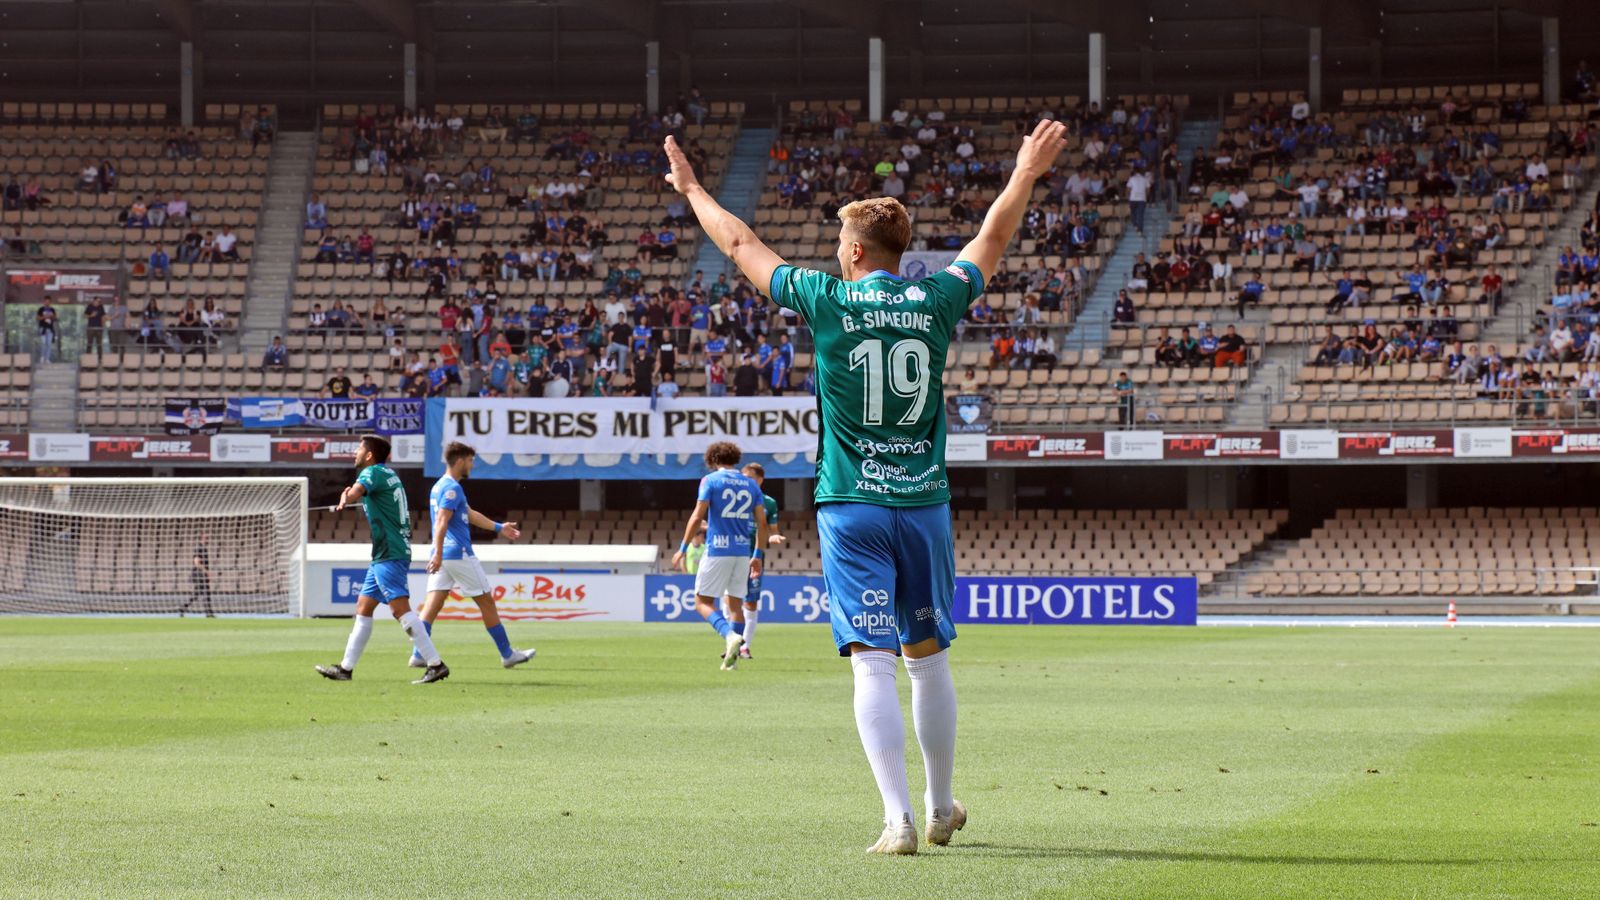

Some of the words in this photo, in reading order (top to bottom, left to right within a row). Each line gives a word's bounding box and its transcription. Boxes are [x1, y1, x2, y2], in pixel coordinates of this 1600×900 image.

[846, 287, 904, 306] indeso
[842, 313, 861, 332] G.
[864, 309, 933, 332] SIMEONE
[849, 338, 930, 426] 19
[303, 402, 369, 421] YOUTH
[450, 409, 493, 437] TU
[507, 409, 598, 439] ERES
[612, 410, 650, 438] MI
[721, 488, 753, 519] 22
[532, 575, 587, 602] Bus
[967, 583, 1176, 620] HIPOTELS
[852, 610, 897, 635] alpha
